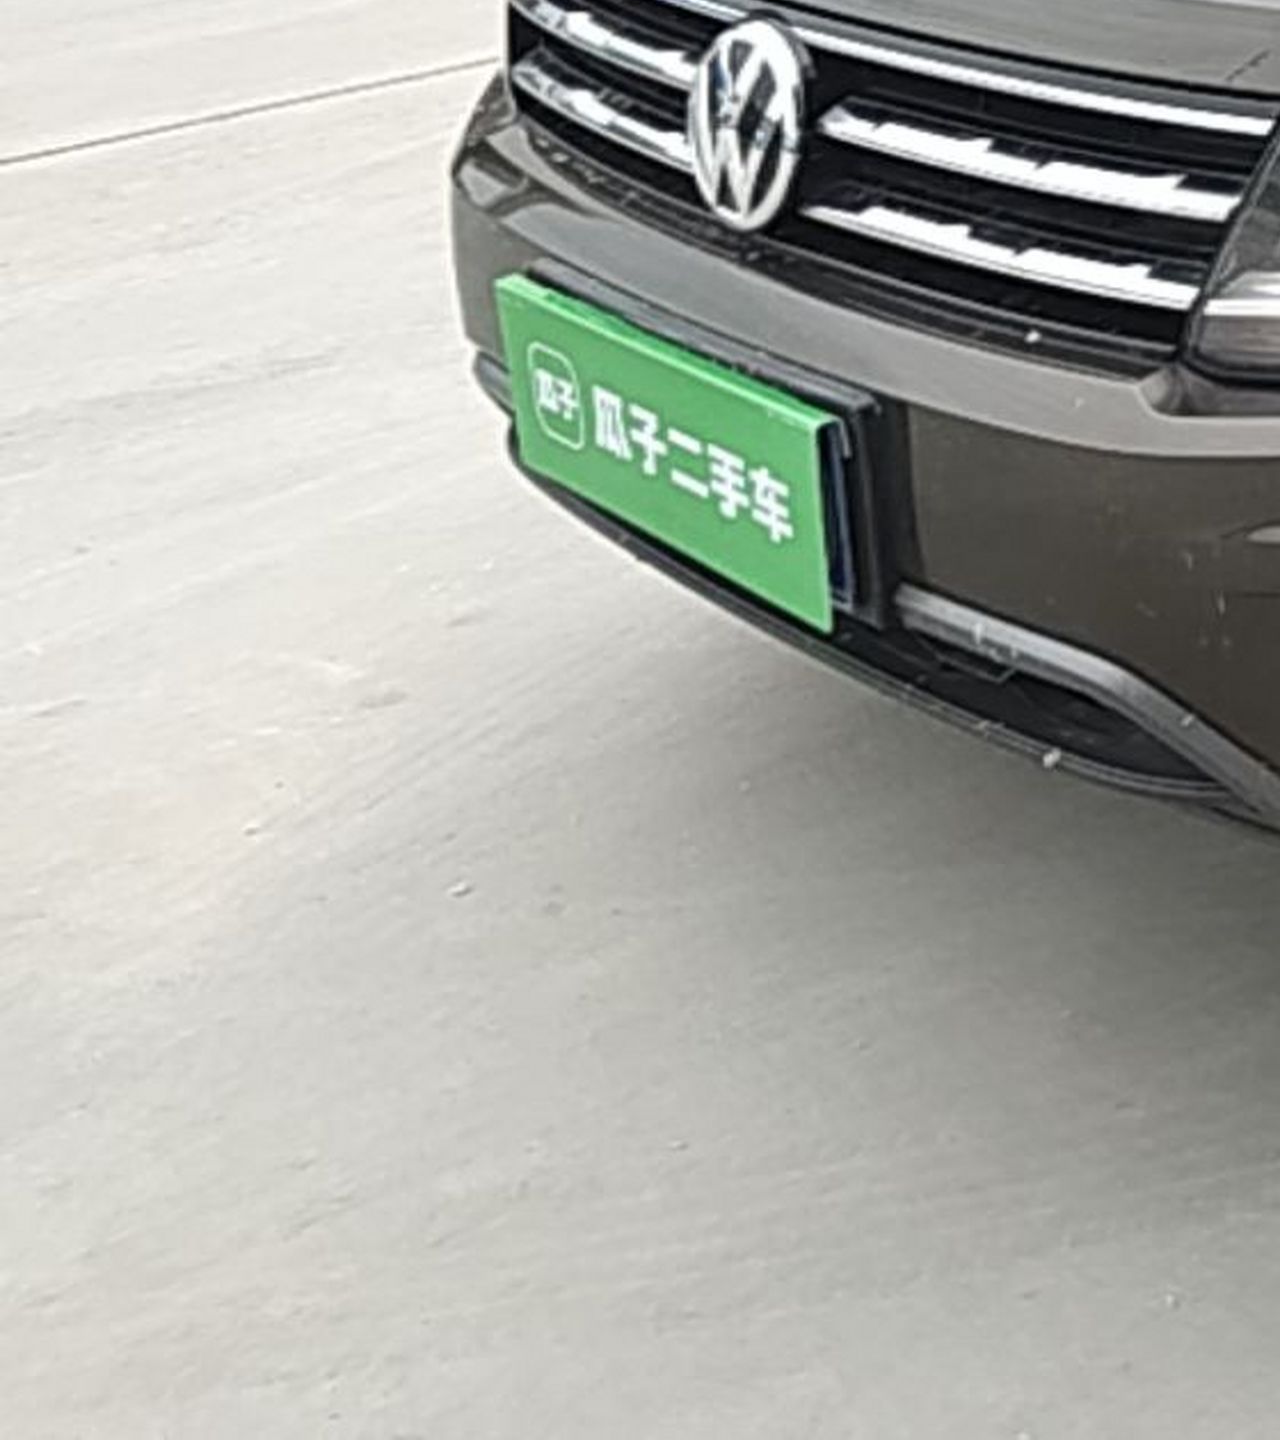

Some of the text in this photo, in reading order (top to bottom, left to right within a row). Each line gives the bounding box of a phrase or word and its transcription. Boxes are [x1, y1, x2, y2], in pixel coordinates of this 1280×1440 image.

[590, 385, 795, 543] 瓜子二手车
